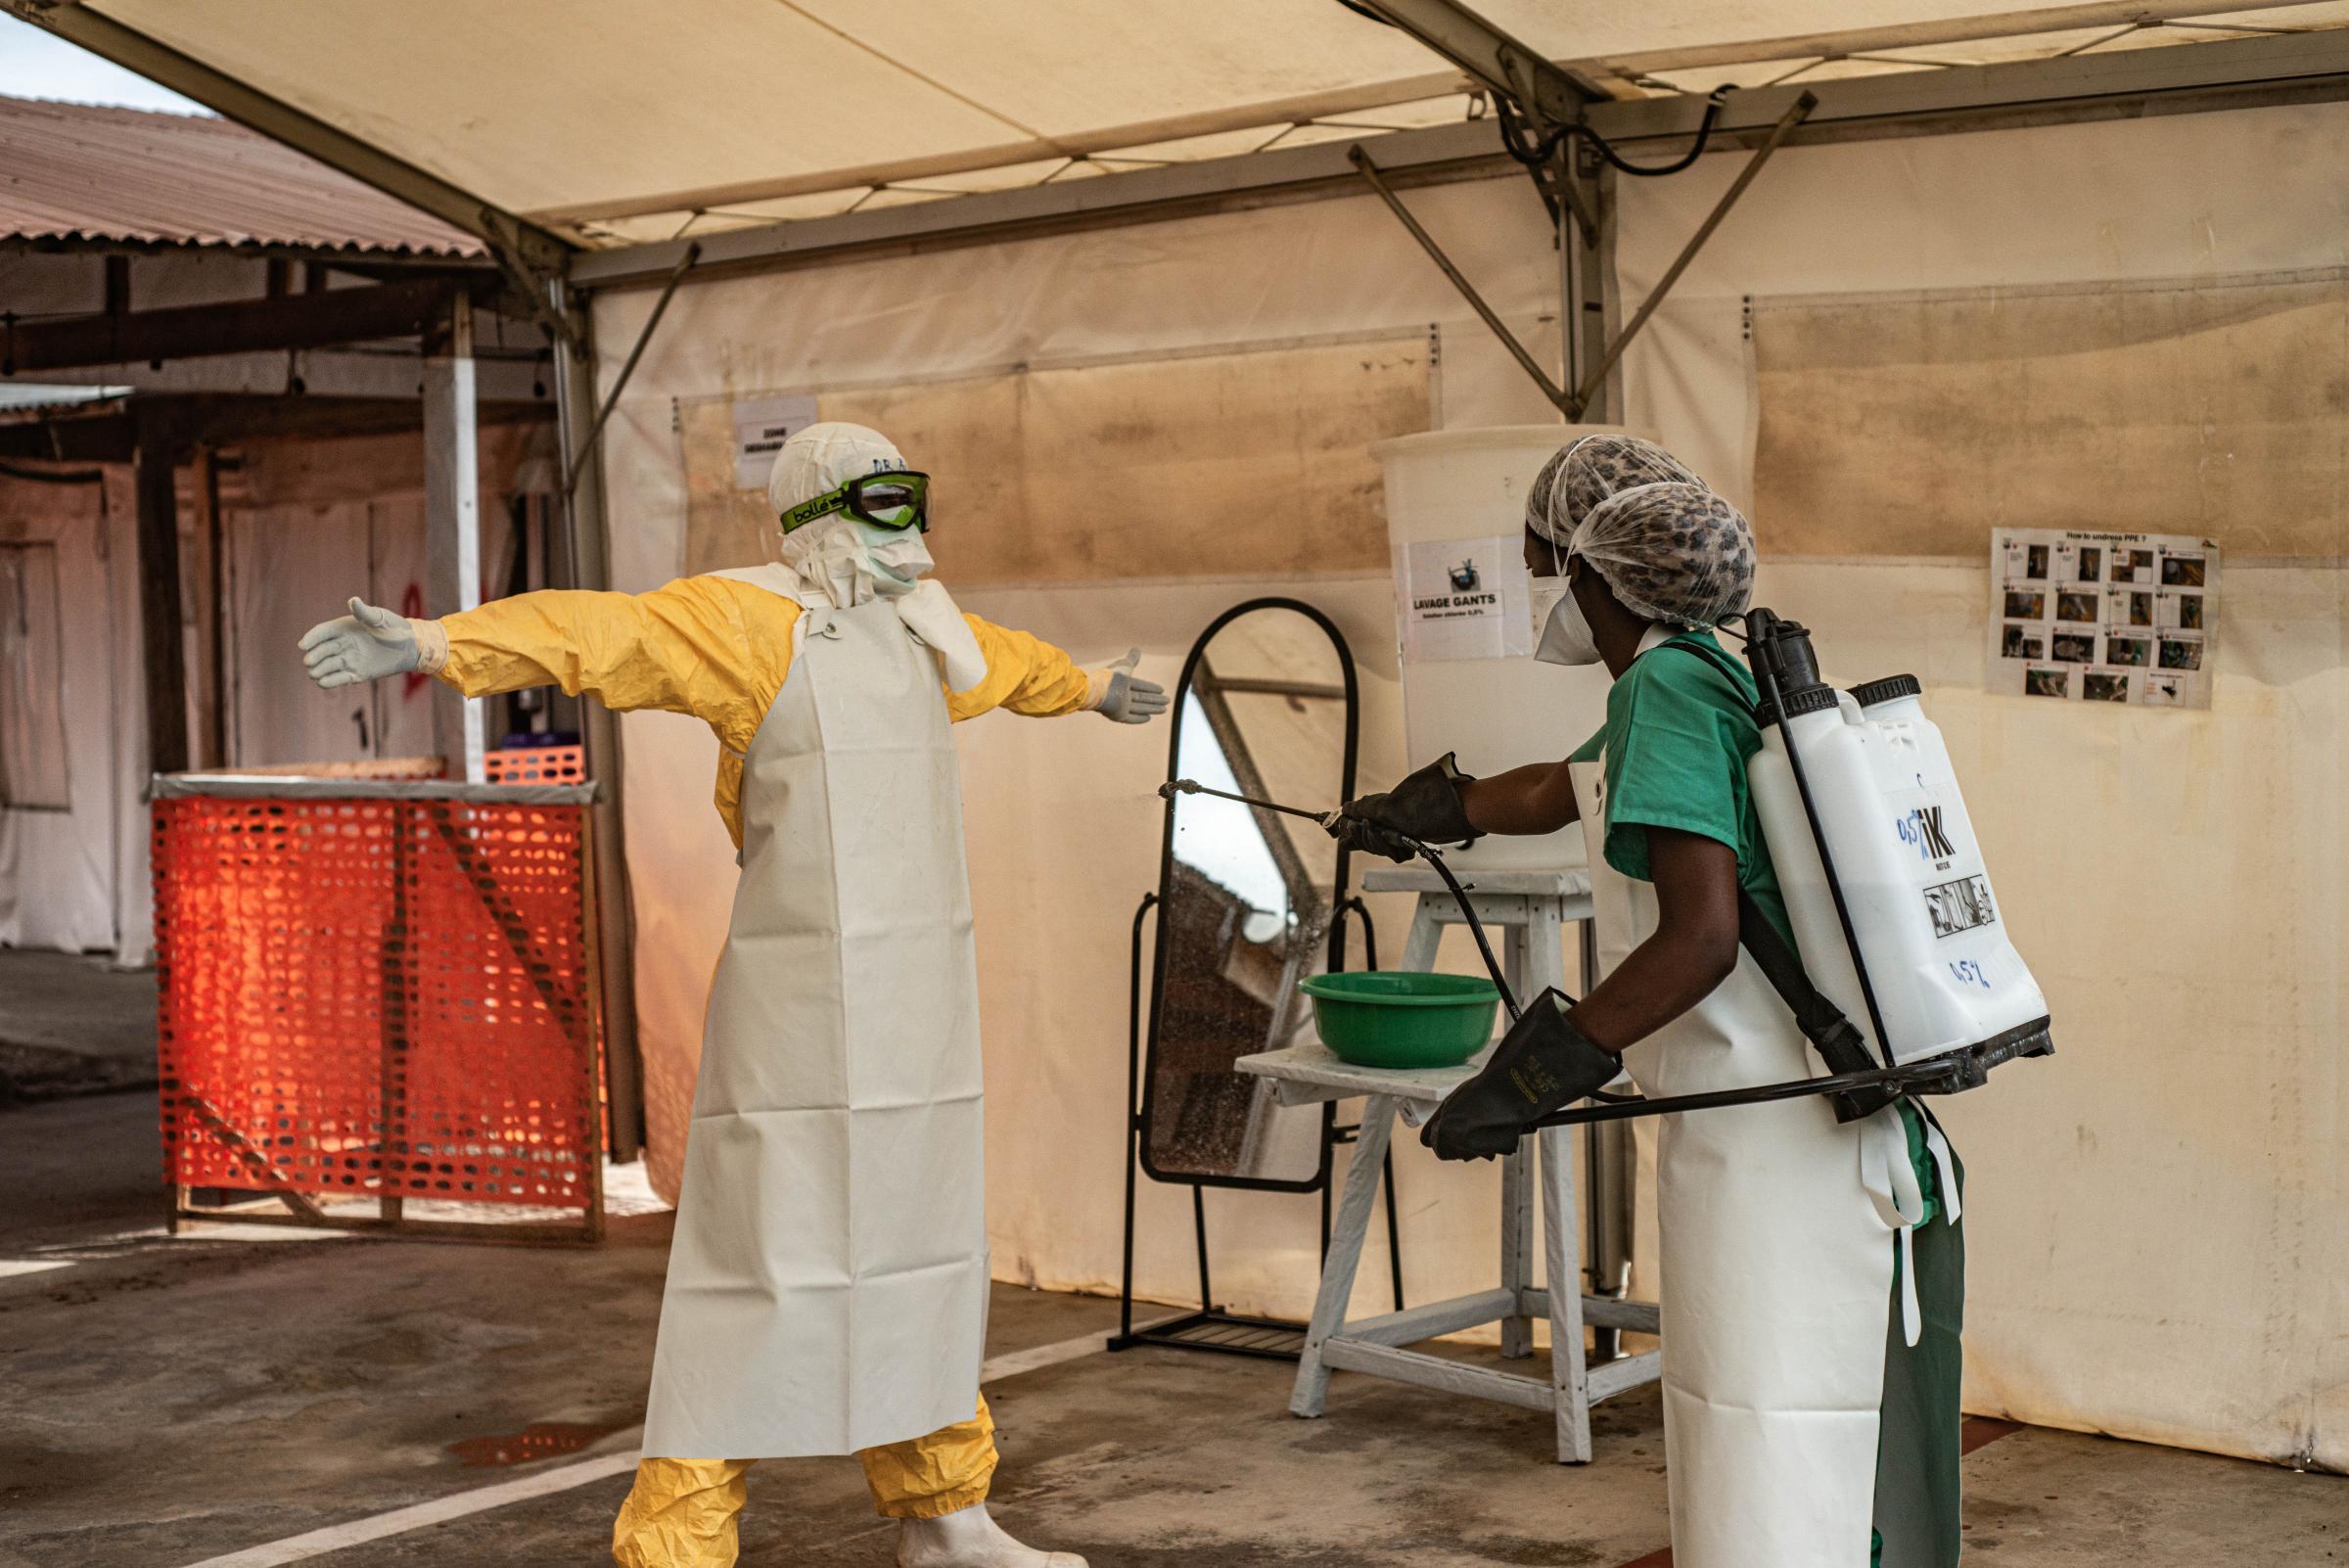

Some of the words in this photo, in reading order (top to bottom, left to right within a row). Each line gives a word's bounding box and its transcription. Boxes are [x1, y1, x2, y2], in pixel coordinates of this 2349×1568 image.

[794, 498, 830, 523] bollé
[2093, 532, 2123, 541] undress
[2124, 533, 2140, 542] PPE
[1413, 597, 1451, 610] LAVAGE
[1453, 594, 1497, 607] GANTS
[1949, 959, 1991, 989] 0,5%
